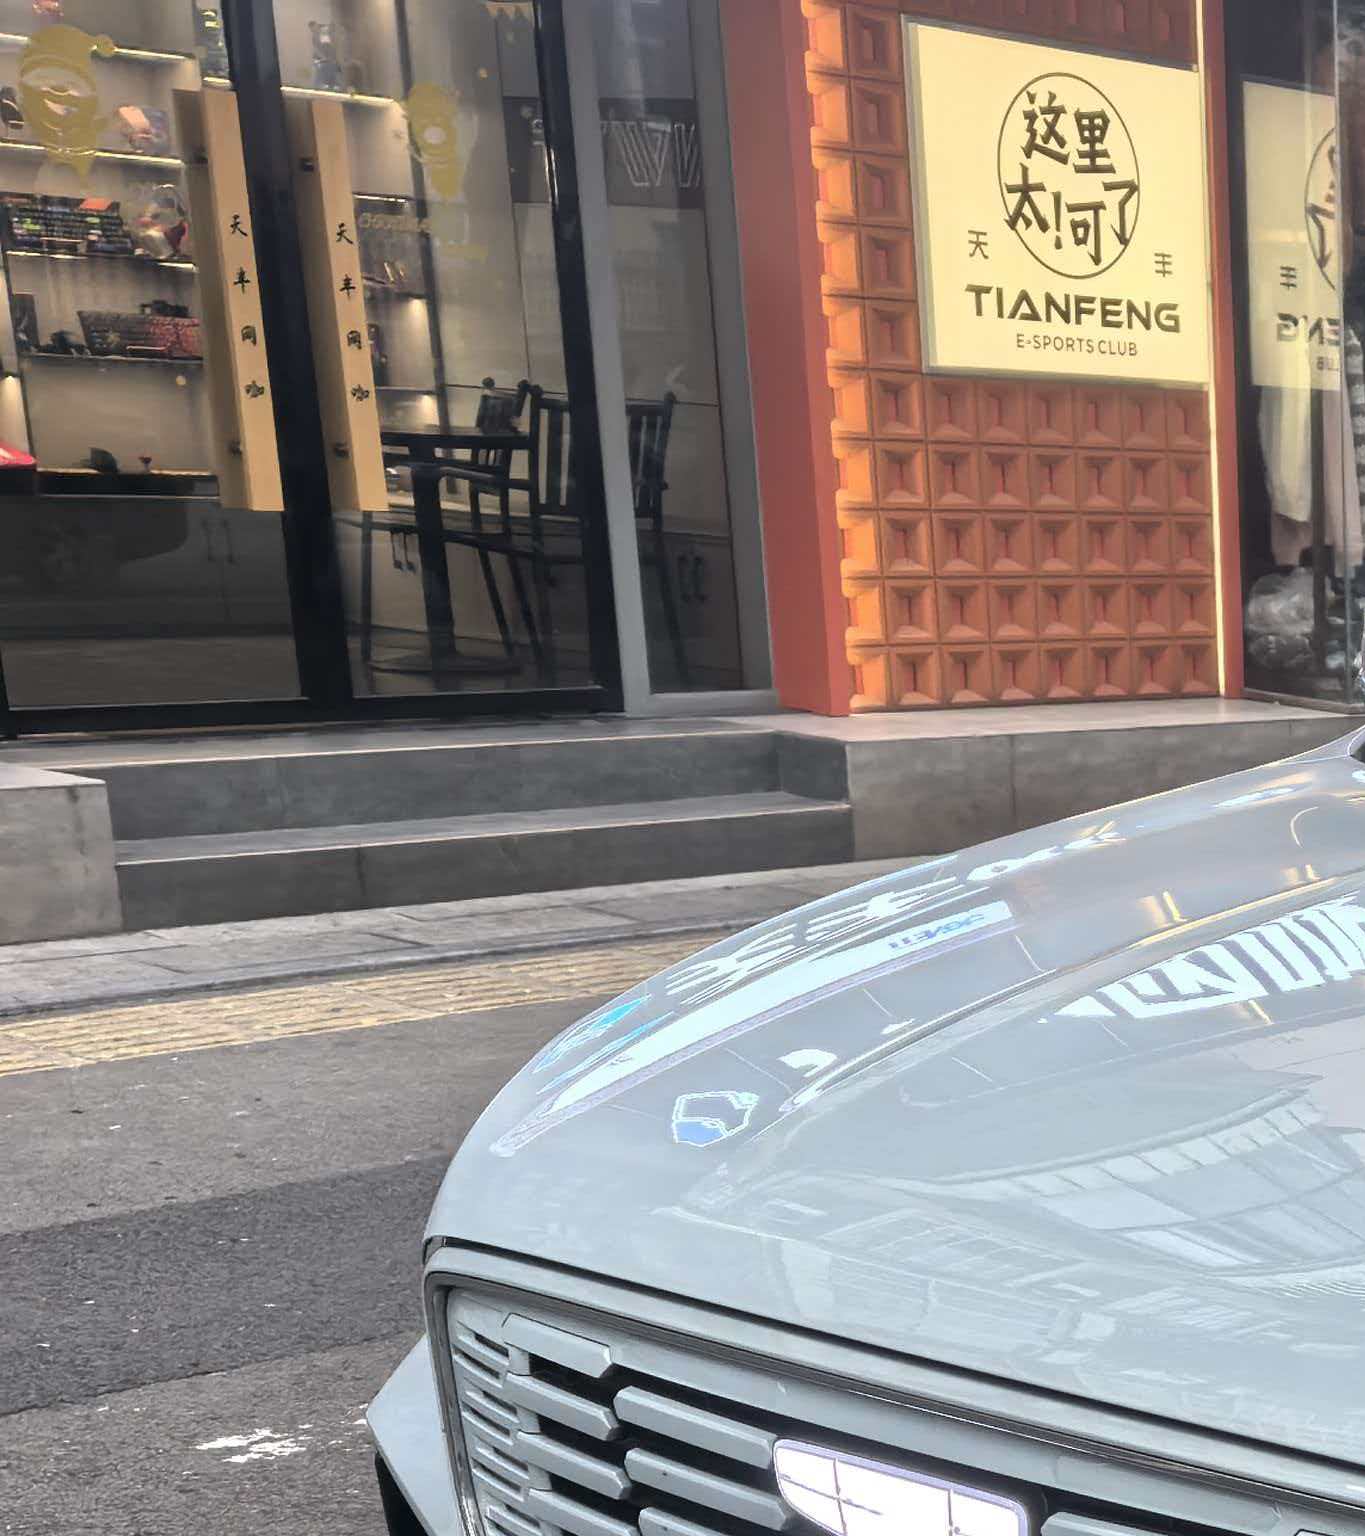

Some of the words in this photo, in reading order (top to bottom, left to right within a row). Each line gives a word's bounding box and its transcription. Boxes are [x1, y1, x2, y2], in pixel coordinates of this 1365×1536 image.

[1021, 90, 1116, 174] 这里
[967, 229, 989, 260] 天
[1154, 252, 1173, 278] 丰
[965, 284, 1181, 333] TIANFENG
